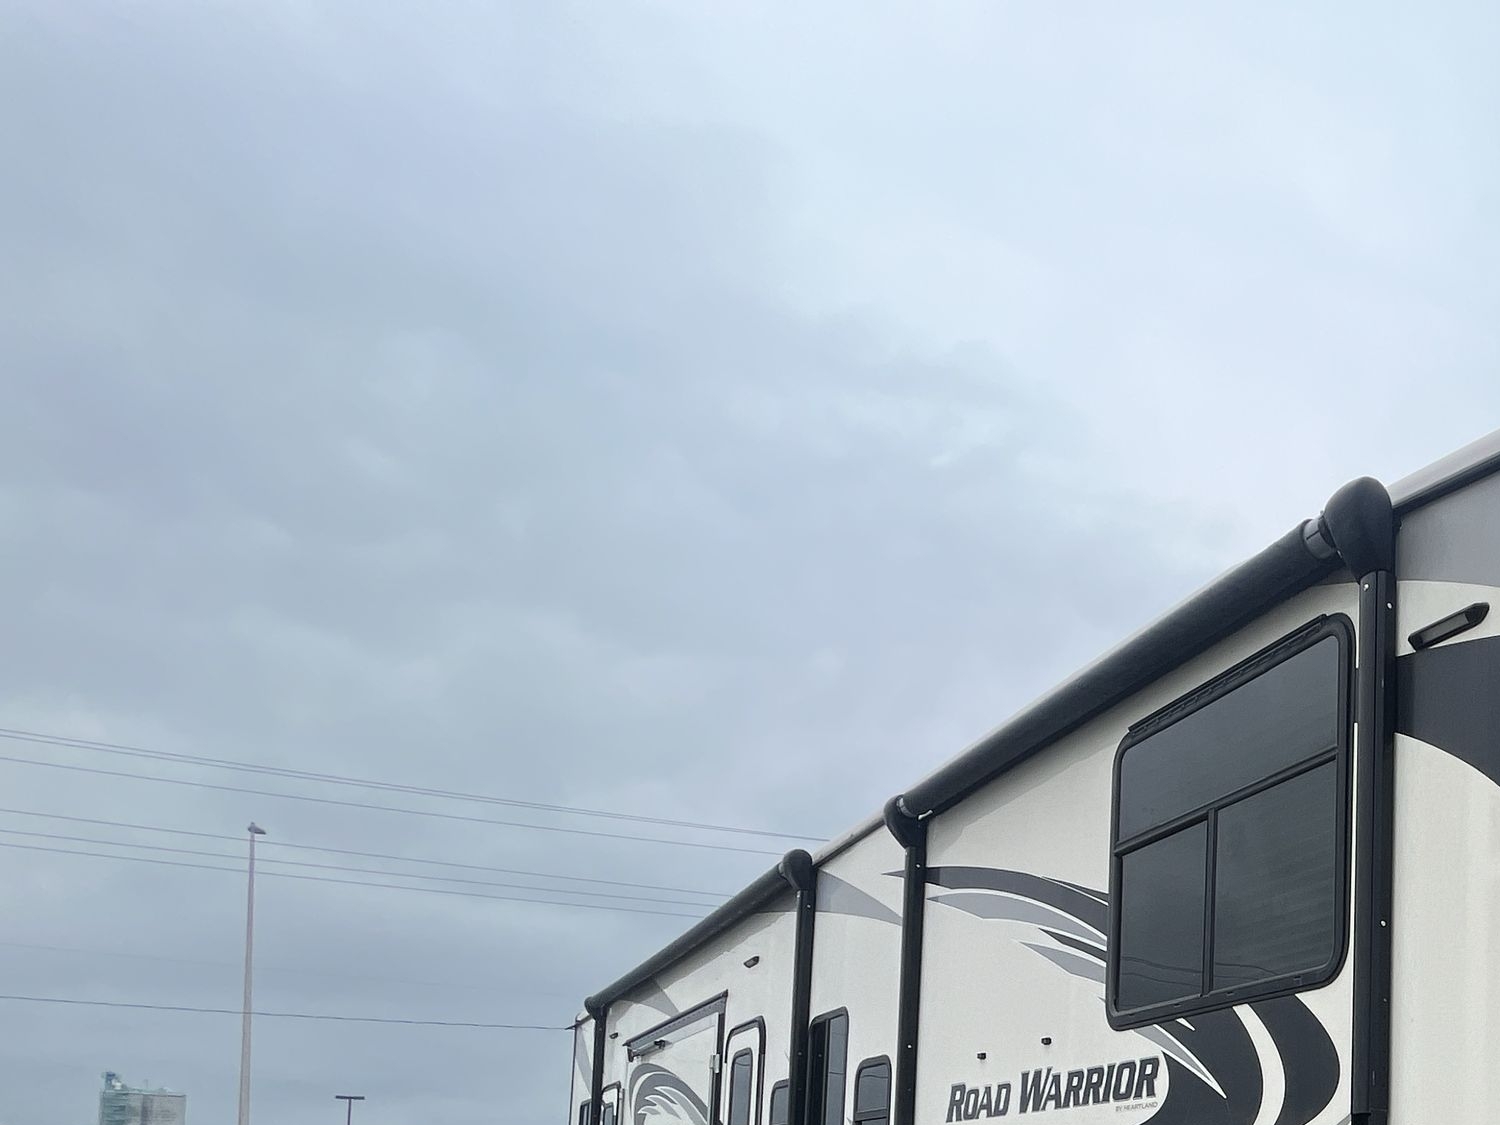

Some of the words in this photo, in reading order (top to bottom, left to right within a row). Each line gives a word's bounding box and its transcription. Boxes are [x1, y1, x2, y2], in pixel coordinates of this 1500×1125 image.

[946, 1082, 1012, 1123] ROAD
[1018, 1055, 1160, 1114] WARRIOR
[1124, 1102, 1158, 1111] HEARTLAND
